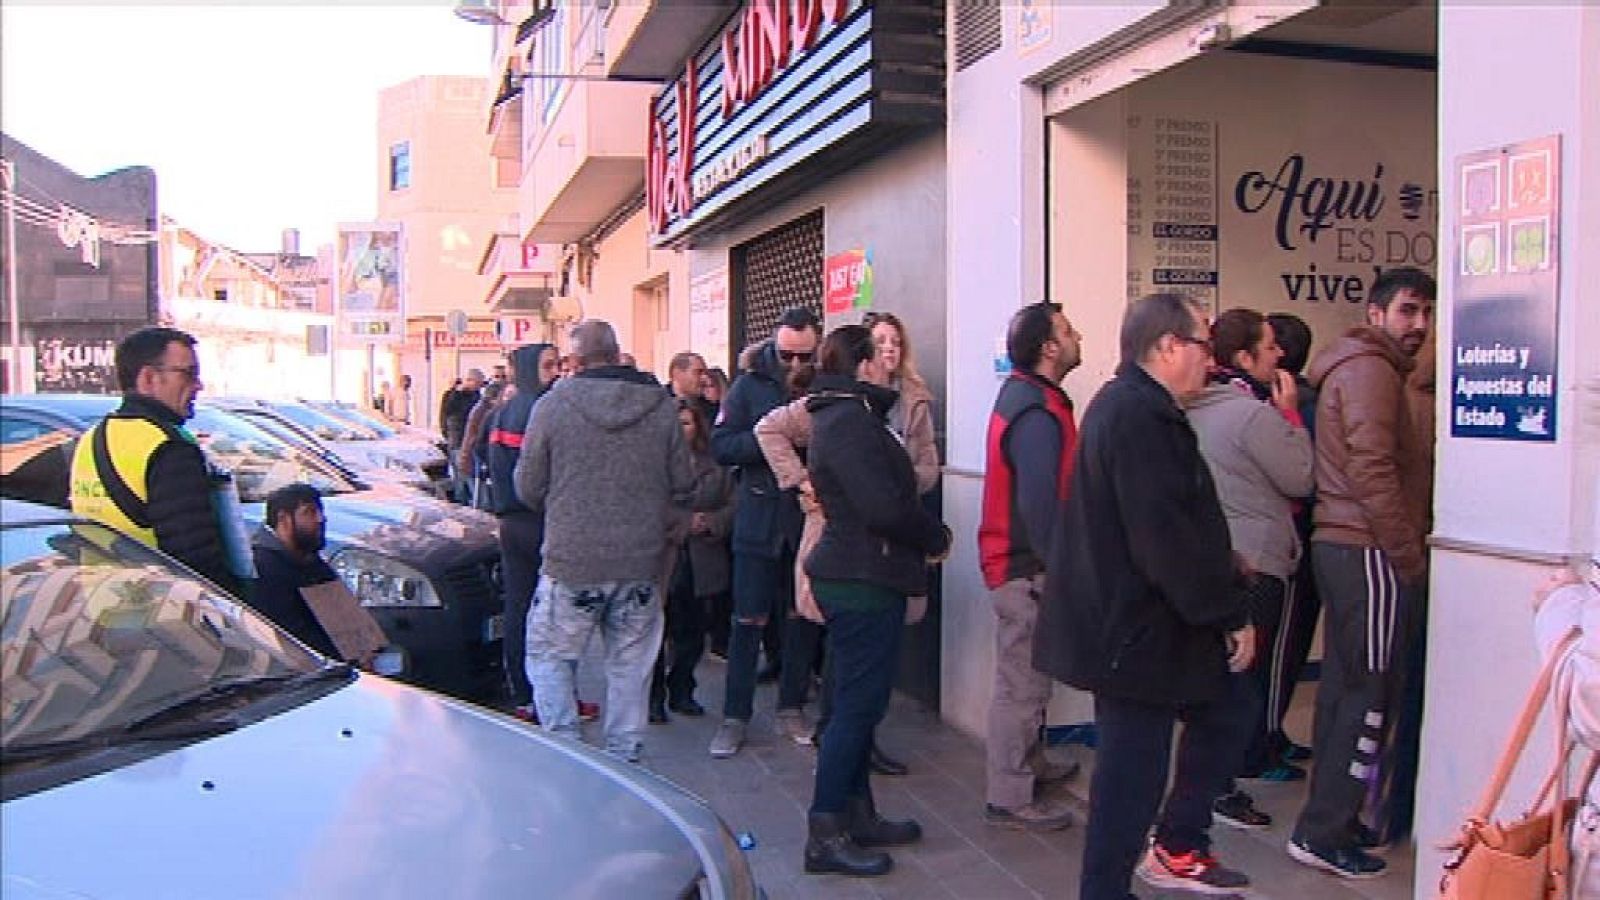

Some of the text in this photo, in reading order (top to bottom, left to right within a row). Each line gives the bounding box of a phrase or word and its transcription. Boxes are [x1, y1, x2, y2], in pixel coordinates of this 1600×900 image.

[721, 0, 850, 119] MIND
[521, 240, 539, 269] P
[1336, 227, 1437, 266] ES DO
[1281, 263, 1364, 303] vive
[515, 319, 531, 341] P
[1519, 348, 1530, 370] y
[1456, 374, 1551, 401] Apuestas del
[1456, 405, 1506, 426] Estado
